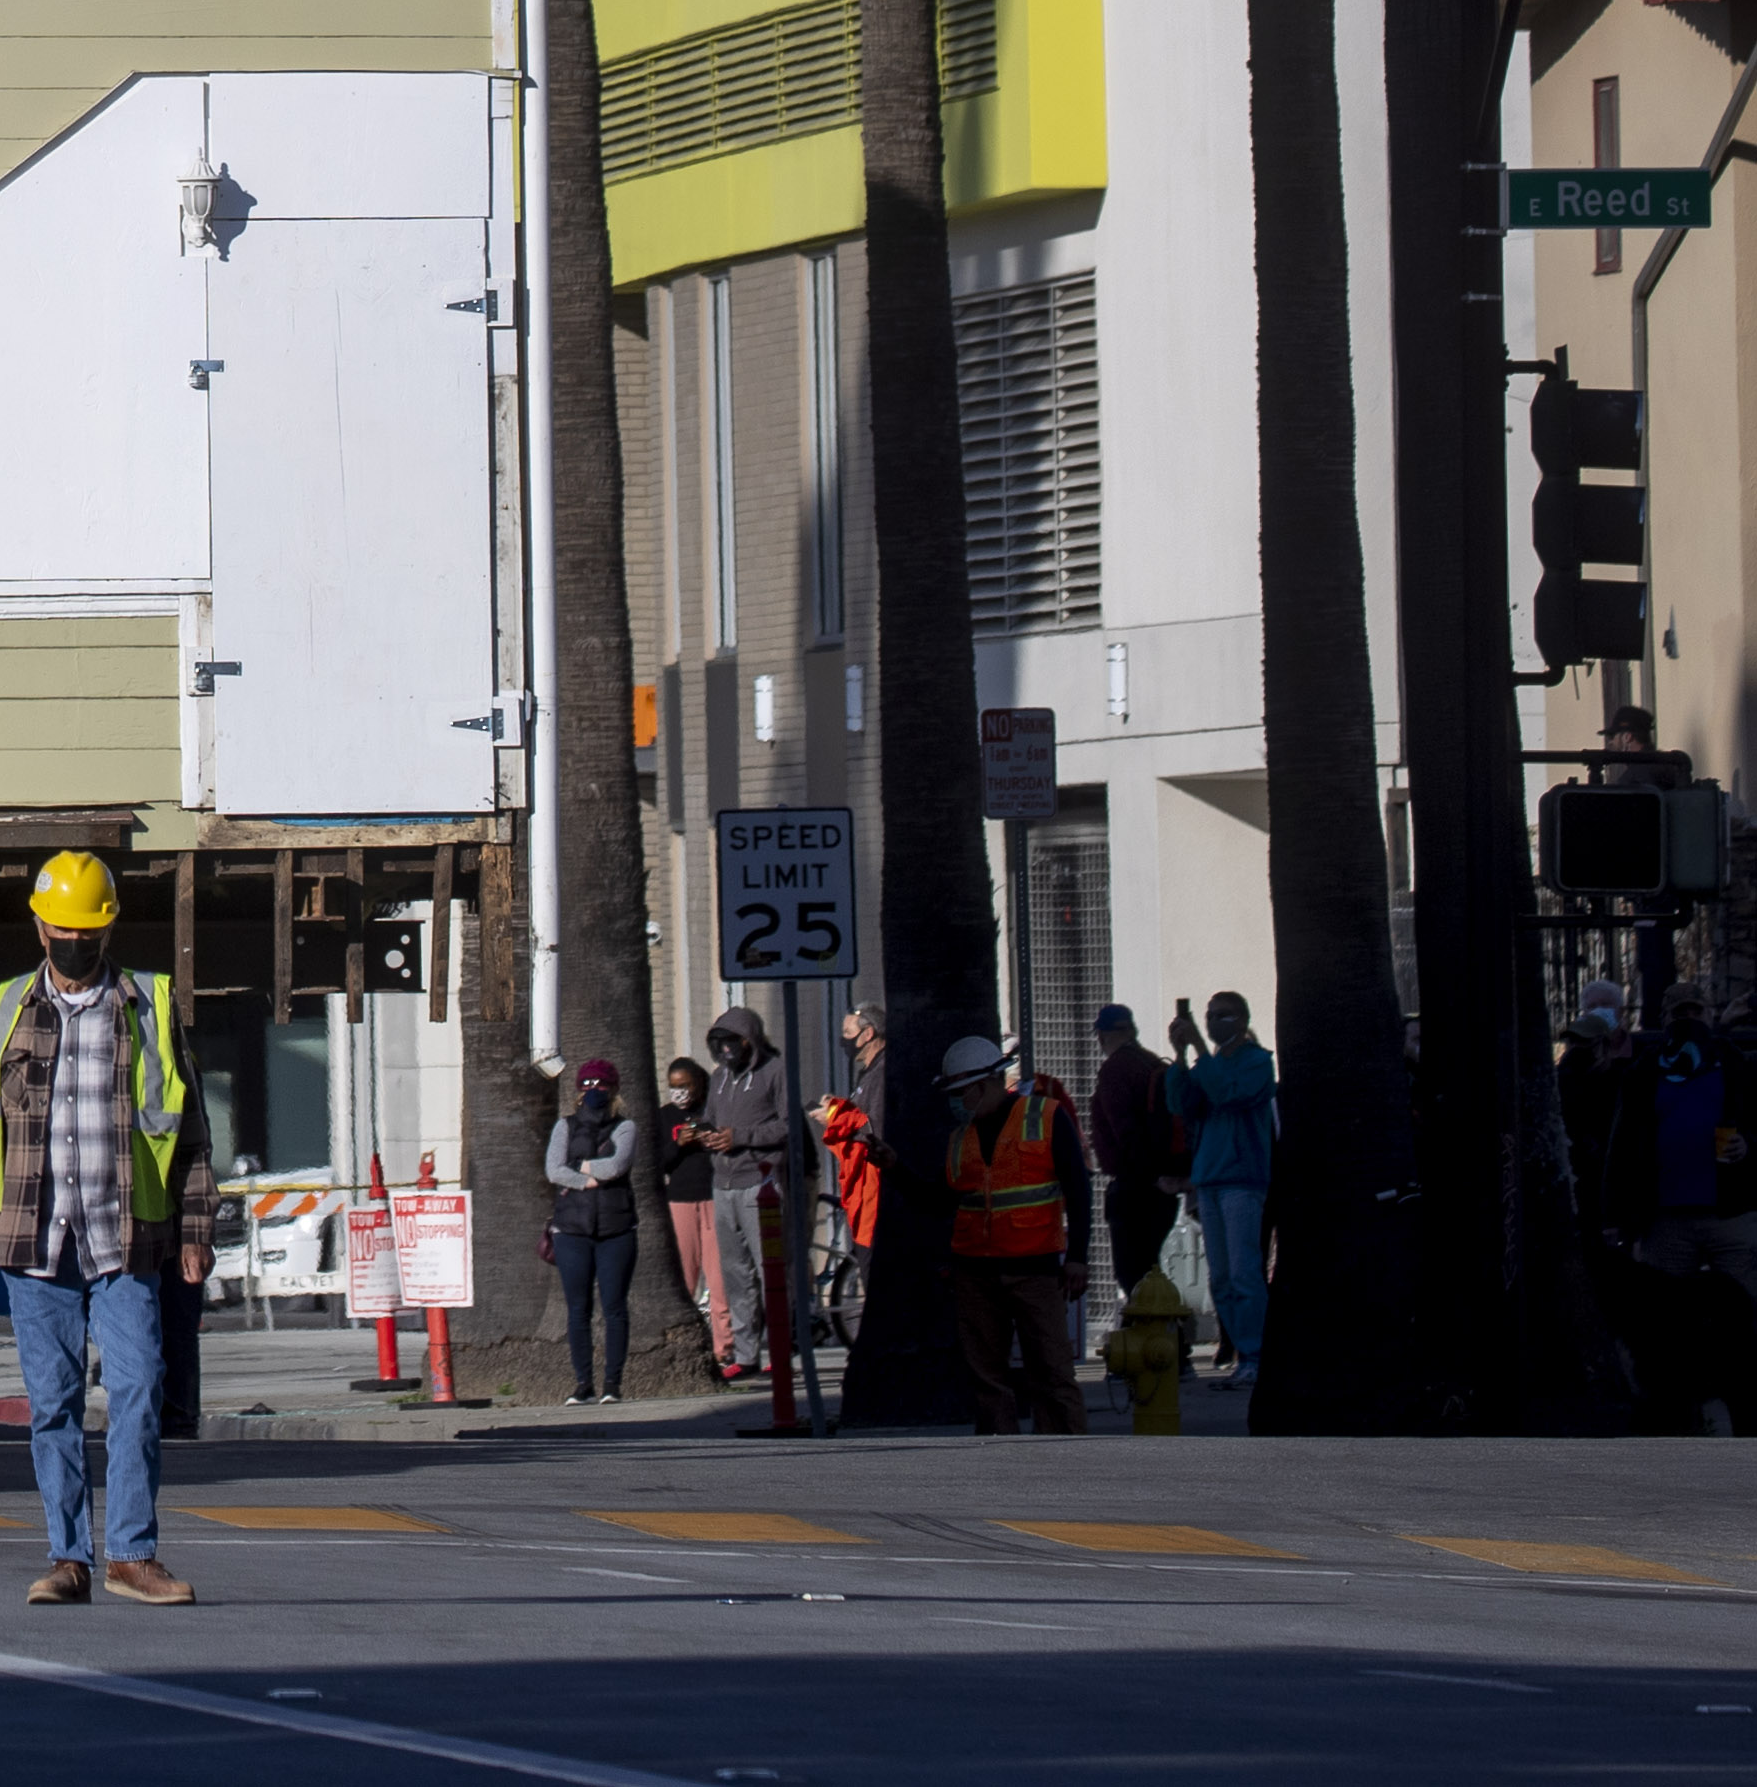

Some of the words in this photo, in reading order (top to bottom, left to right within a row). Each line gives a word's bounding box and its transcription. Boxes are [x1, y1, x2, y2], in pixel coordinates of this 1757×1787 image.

[1529, 197, 1543, 217] E
[1557, 180, 1651, 217] Reed
[1666, 196, 1691, 217] St
[985, 714, 1009, 739] NO
[1013, 717, 1052, 734] PARKING
[987, 776, 1052, 791] THURSDAY
[729, 824, 842, 851] SPEED
[742, 864, 829, 889] LIMIT
[734, 901, 842, 962] 25
[350, 1229, 375, 1261] NO
[396, 1215, 417, 1248] NO
[417, 1223, 465, 1240] STOPPING
